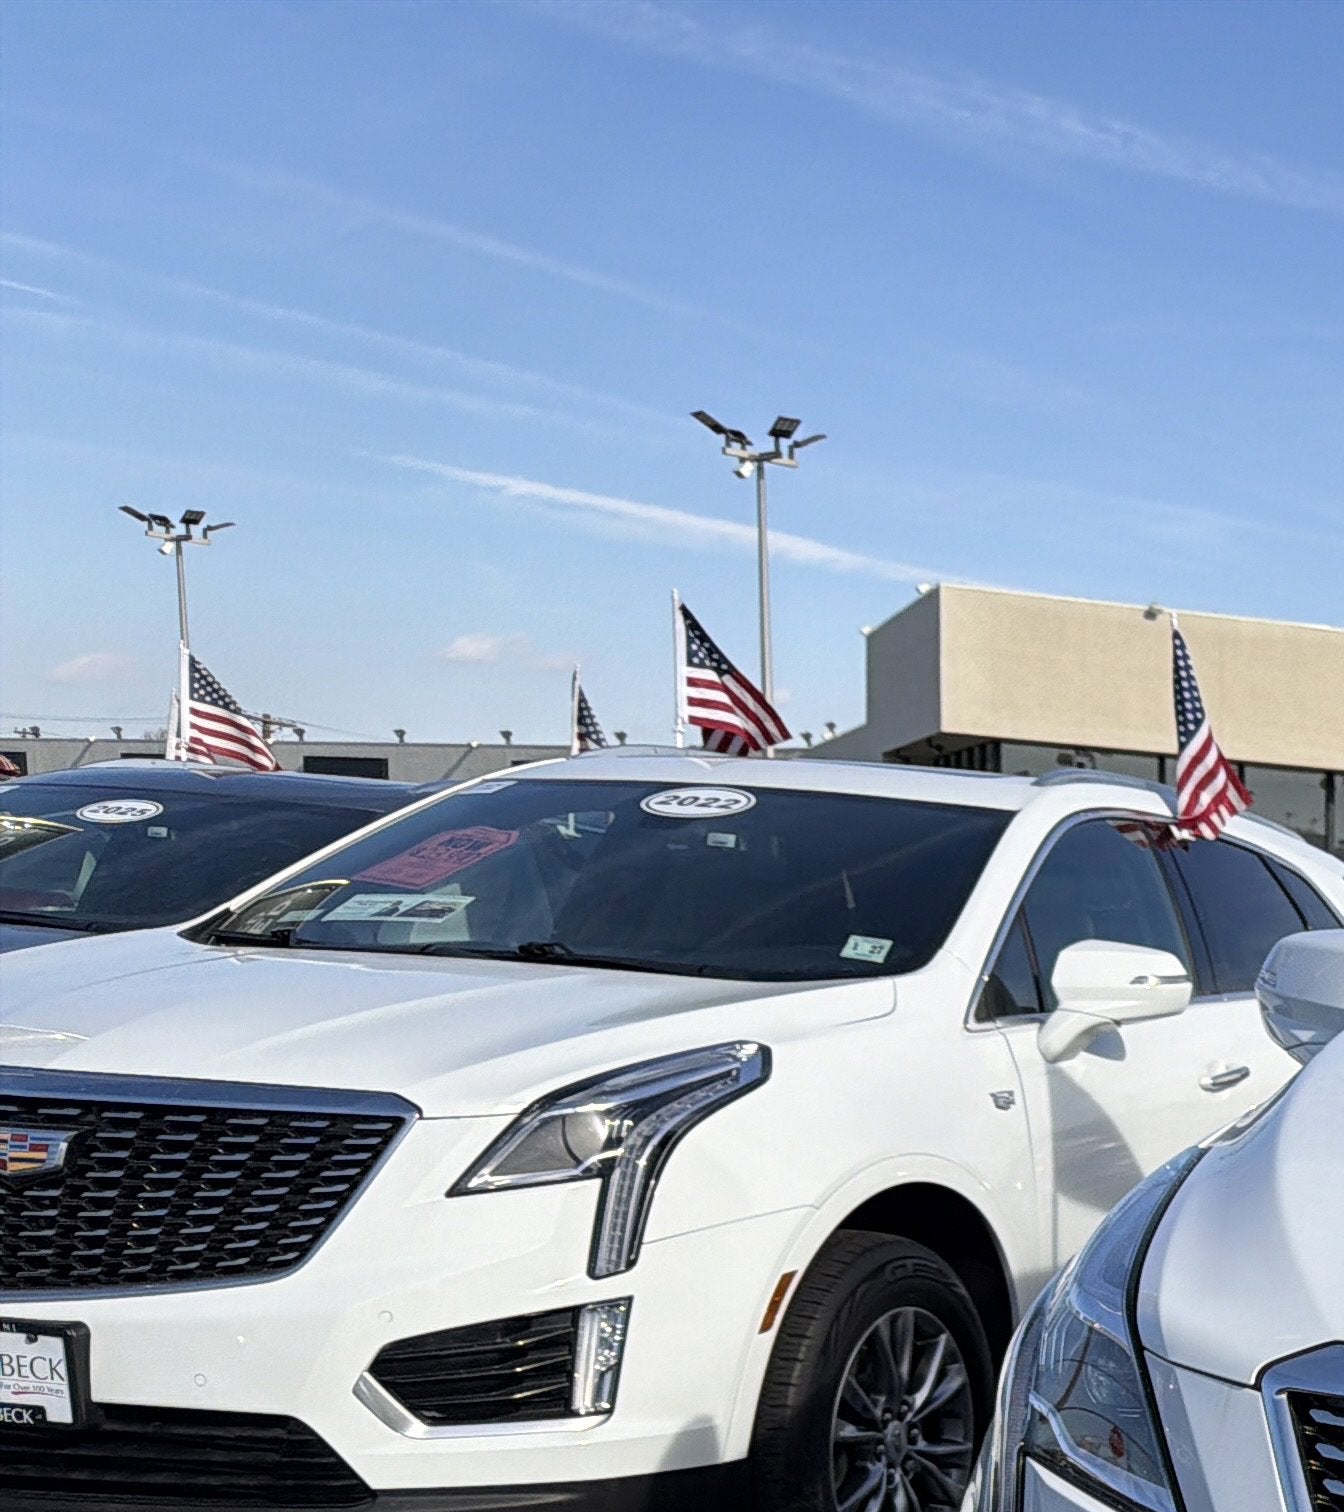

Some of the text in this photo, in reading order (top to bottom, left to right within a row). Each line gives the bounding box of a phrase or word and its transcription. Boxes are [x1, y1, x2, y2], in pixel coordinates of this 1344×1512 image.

[654, 795, 742, 809] 2022
[87, 805, 151, 816] 2025
[0, 1353, 65, 1382] BECK
